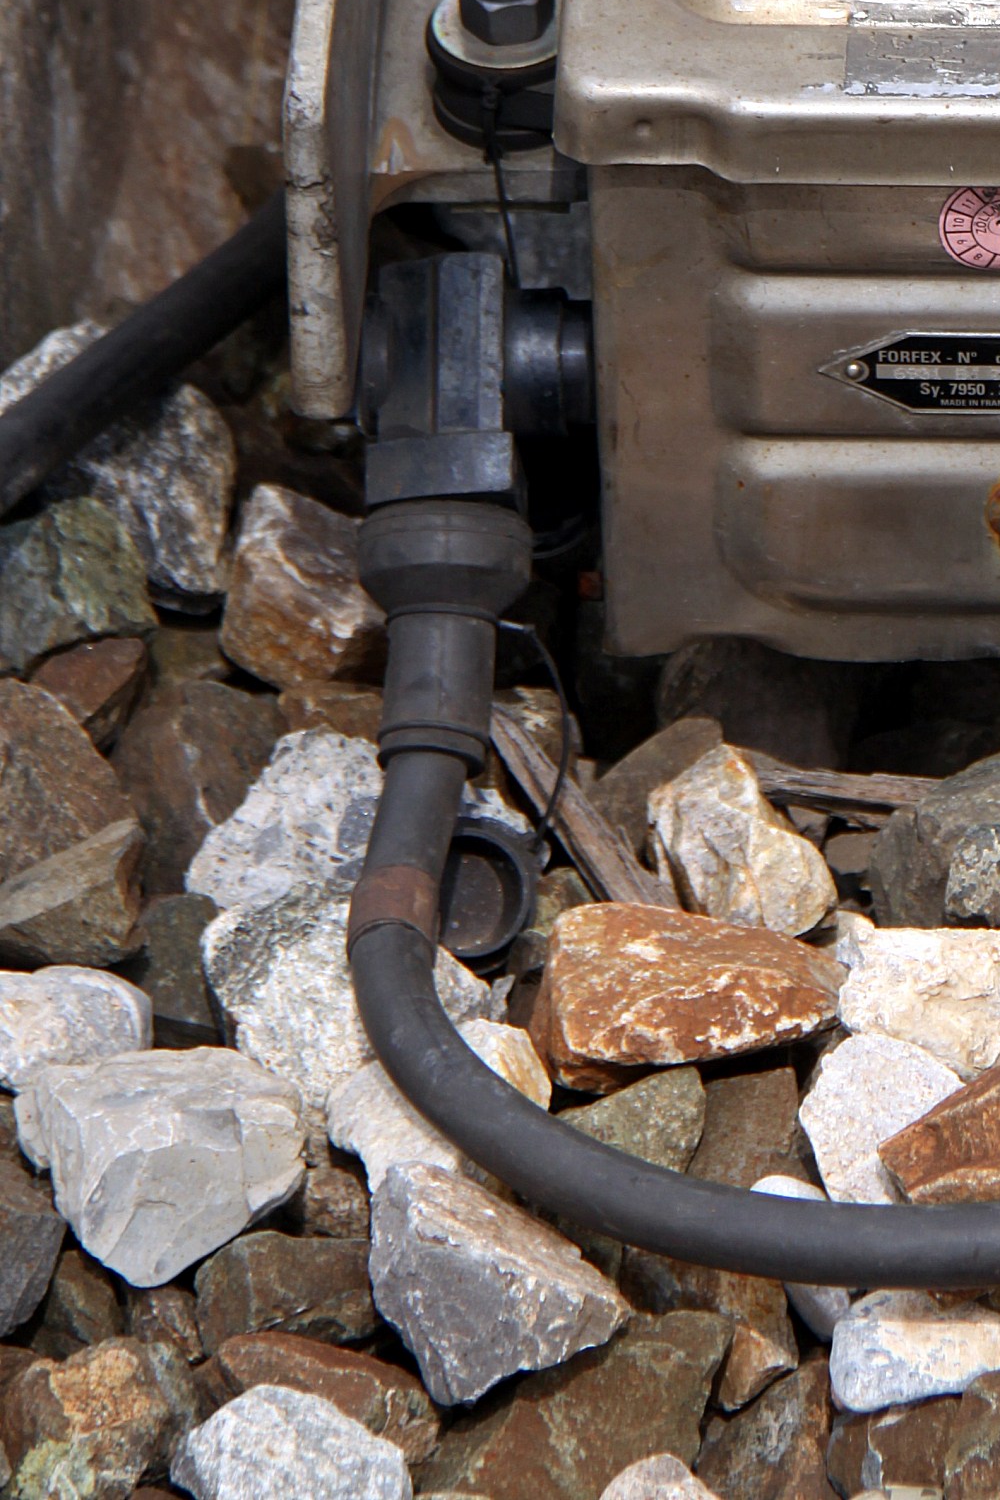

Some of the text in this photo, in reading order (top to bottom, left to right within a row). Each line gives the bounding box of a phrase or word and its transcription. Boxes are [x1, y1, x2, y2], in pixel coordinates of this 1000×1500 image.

[953, 218, 964, 228] 10
[878, 350, 942, 363] FORFEX
[920, 382, 944, 397] Sy.
[950, 384, 986, 396] 7950
[940, 399, 966, 407] MADE
[969, 399, 978, 407] IN
